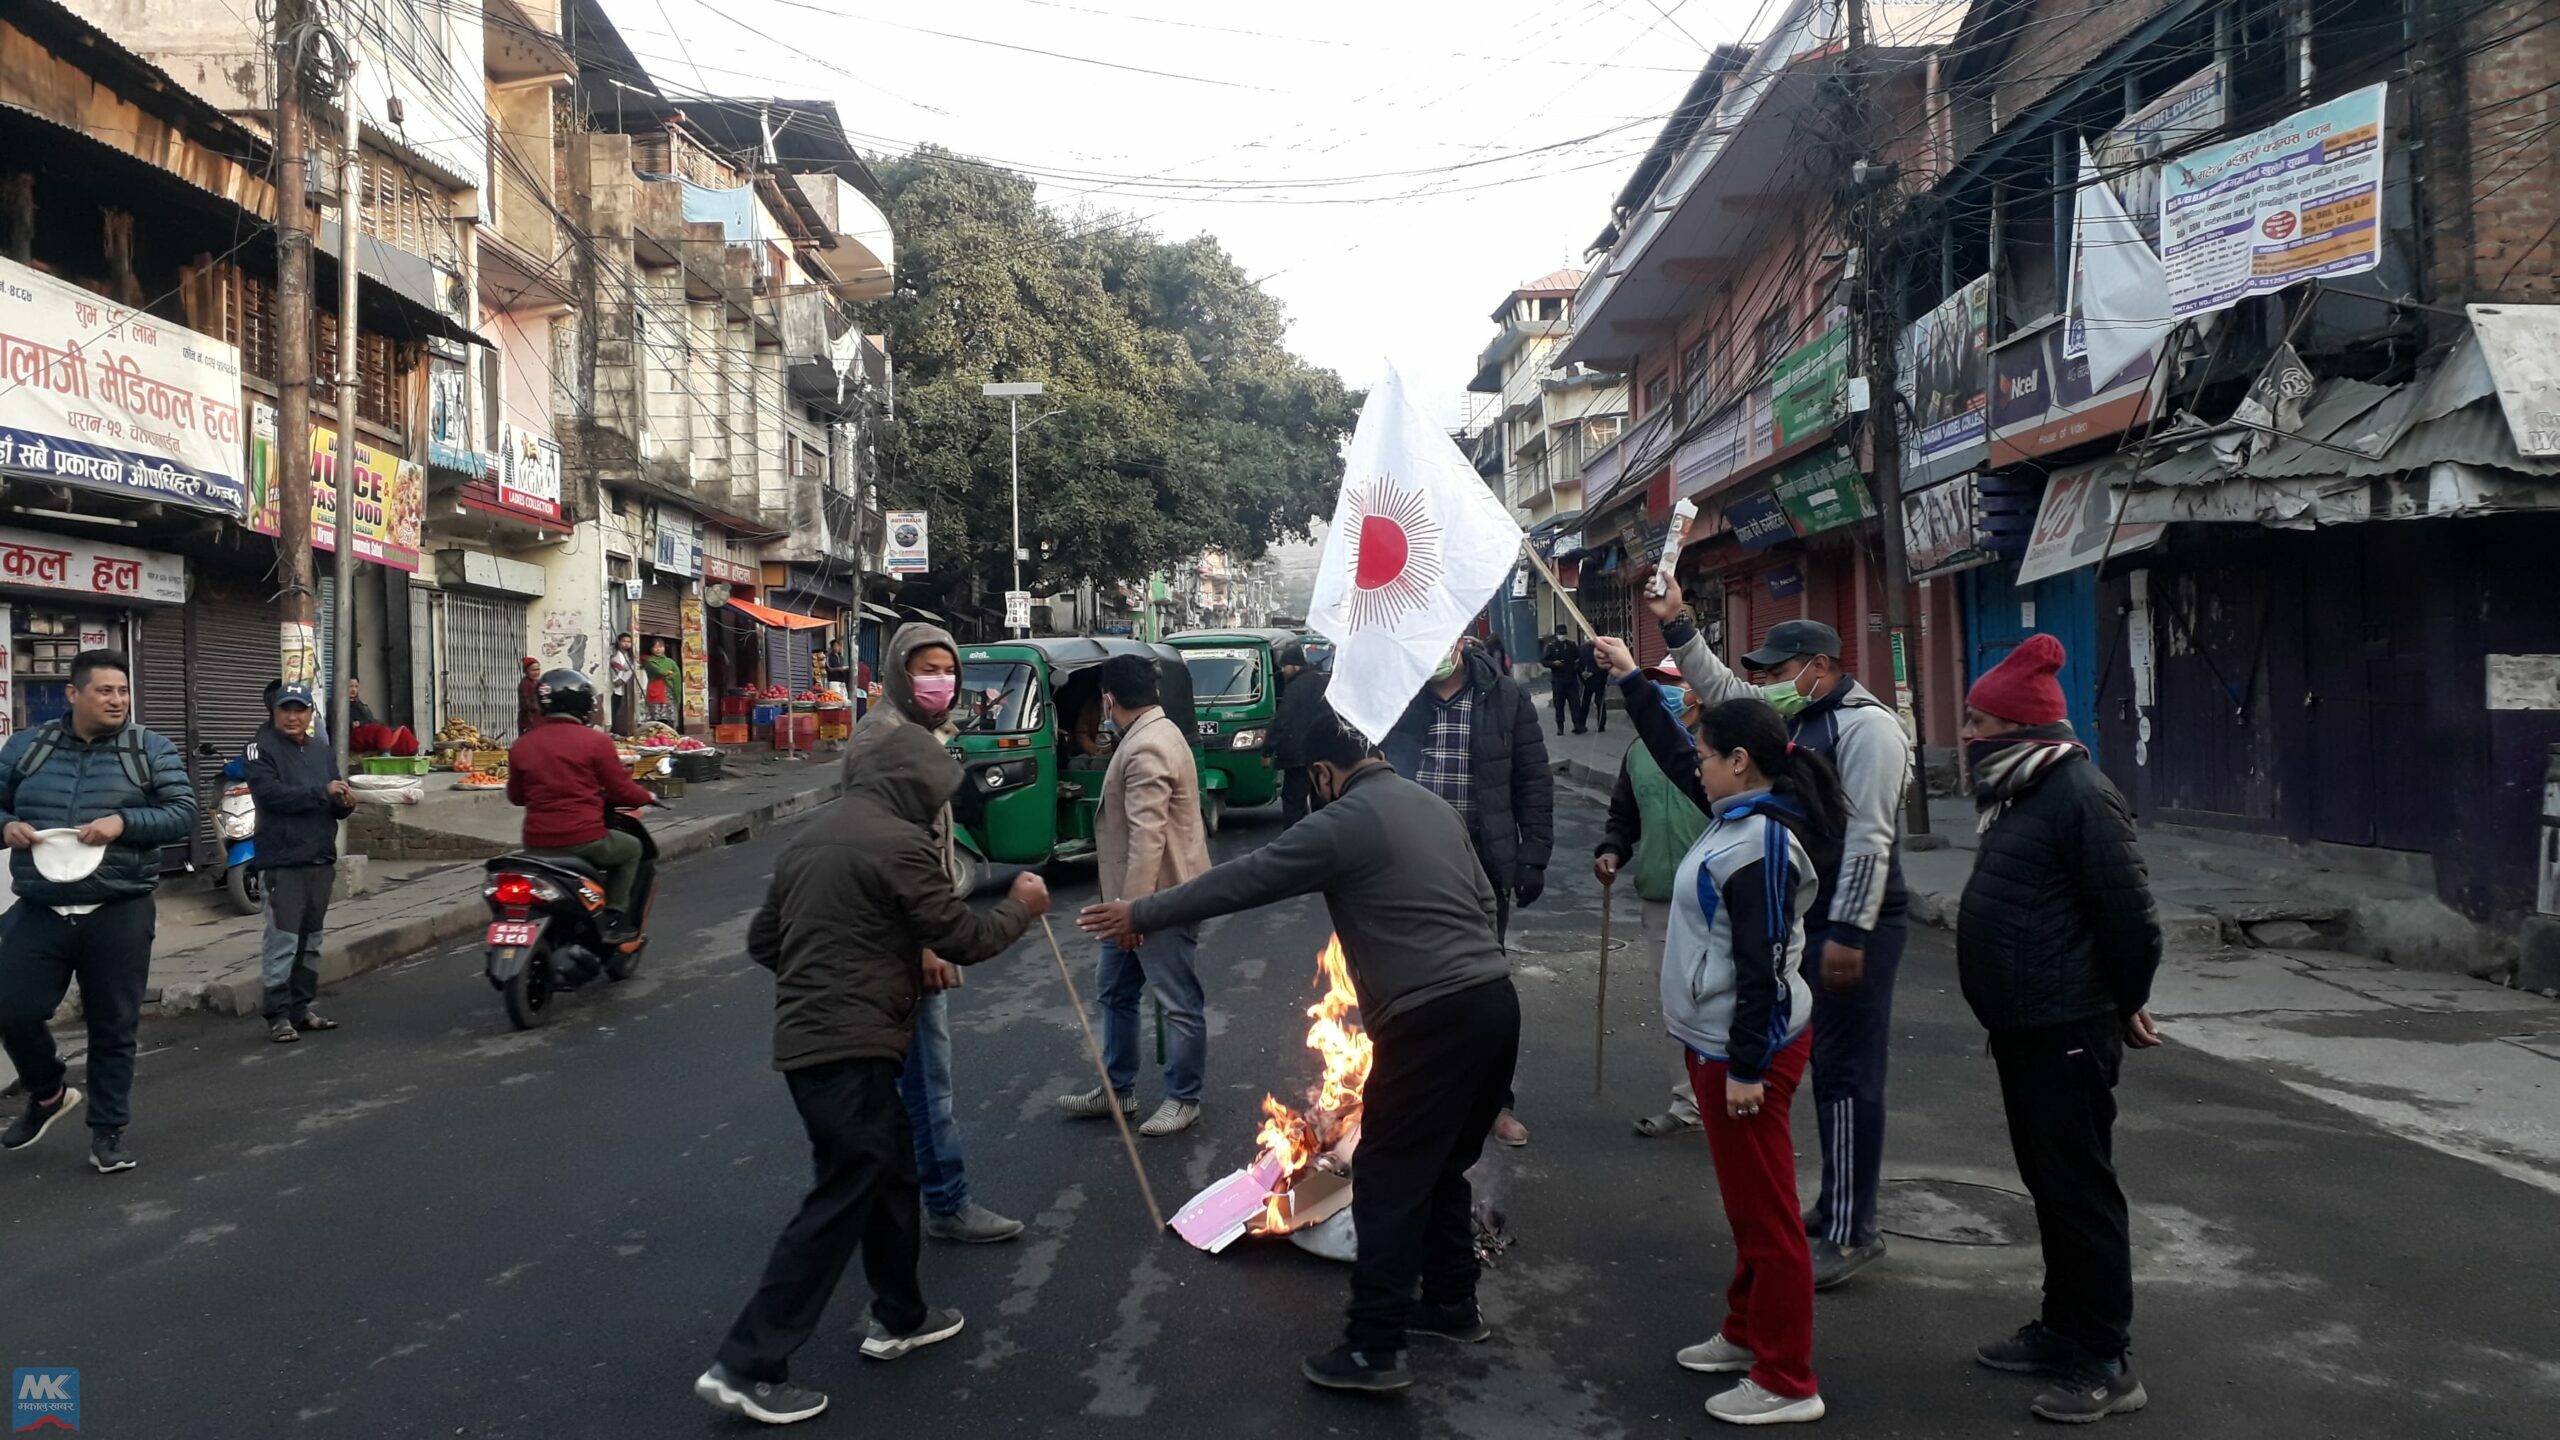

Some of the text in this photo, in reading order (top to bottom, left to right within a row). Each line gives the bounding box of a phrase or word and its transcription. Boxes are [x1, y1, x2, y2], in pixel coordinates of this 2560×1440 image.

[75, 301, 157, 347] शुभ लाभ
[2173, 301, 2197, 313] ONTACT
[96, 350, 196, 431] मेडिकल
[200, 396, 240, 445] हल
[2011, 368, 2039, 400] Ncell
[18, 438, 49, 470] सबै
[53, 450, 124, 484] प्रकारको
[311, 451, 383, 503] JUCE
[311, 486, 337, 513] FAS
[354, 501, 383, 527] OOD
[525, 496, 554, 515] COLLECTION
[92, 555, 143, 592] हल
